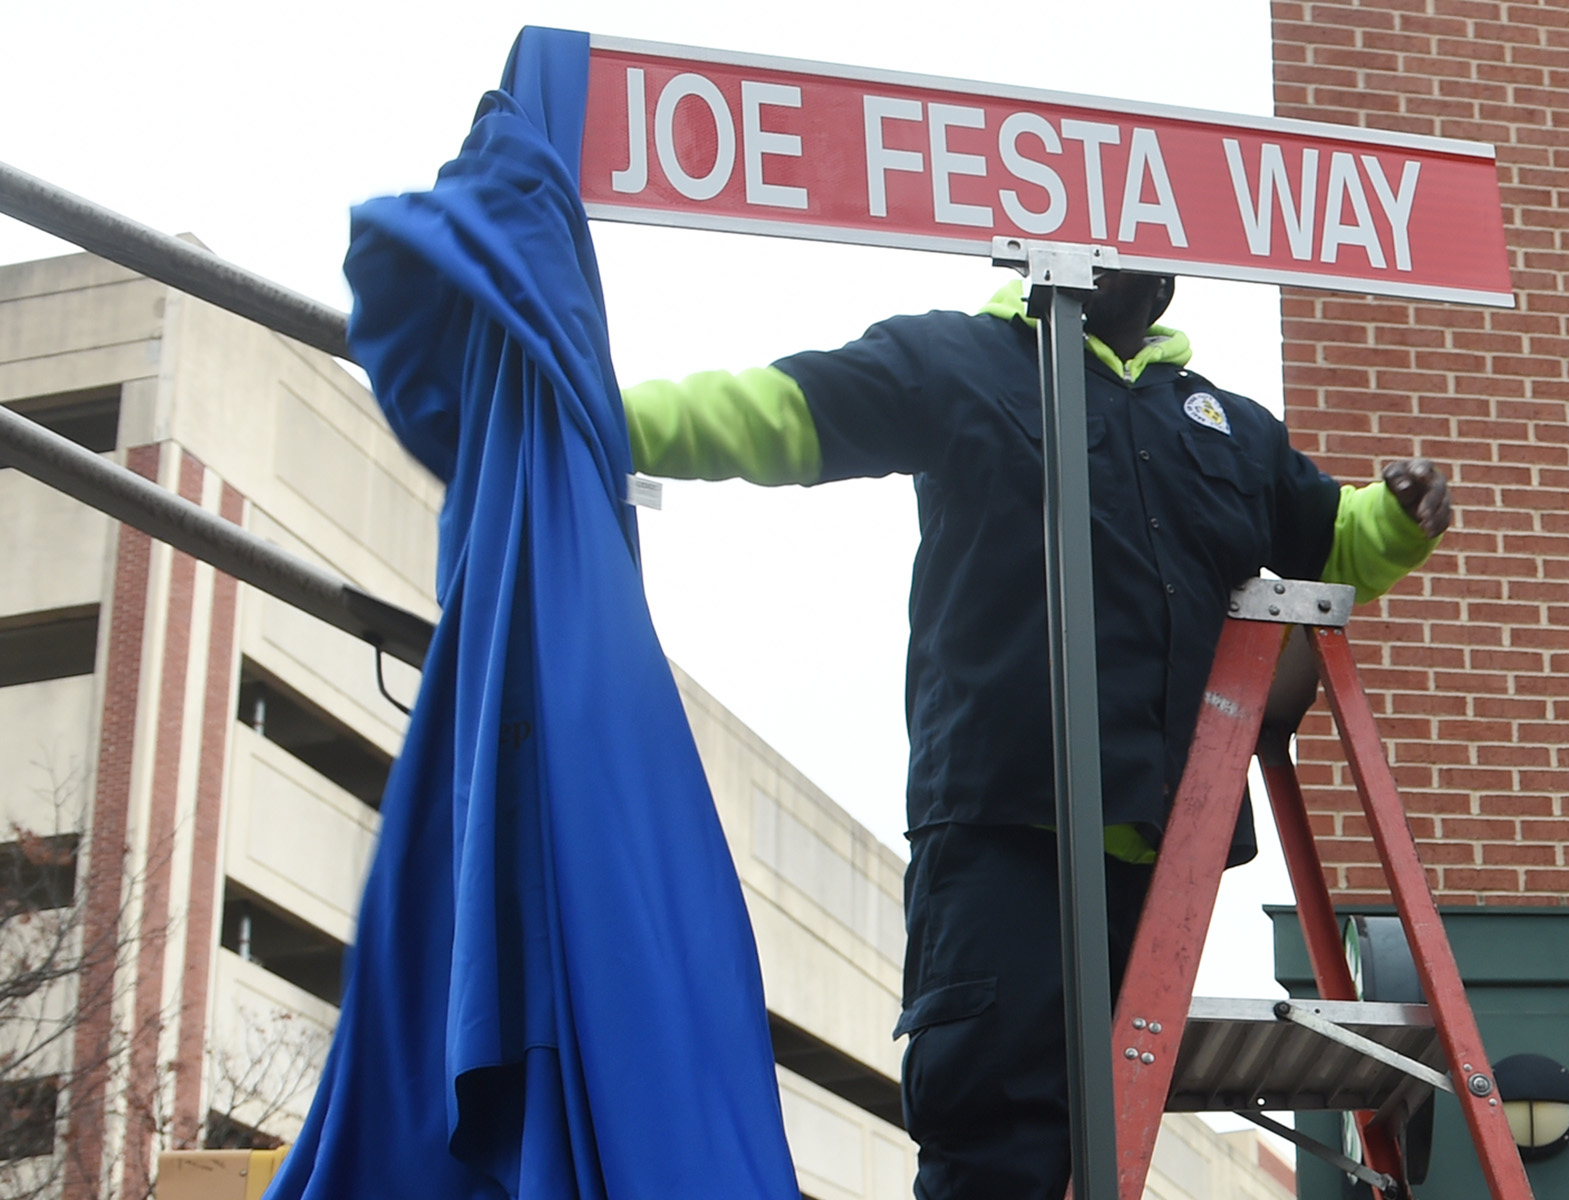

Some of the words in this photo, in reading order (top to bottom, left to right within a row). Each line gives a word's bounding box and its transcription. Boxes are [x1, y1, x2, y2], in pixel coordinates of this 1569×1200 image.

[612, 67, 808, 209] JOE
[862, 93, 1188, 249] FESTA
[1222, 137, 1421, 272] WAY
